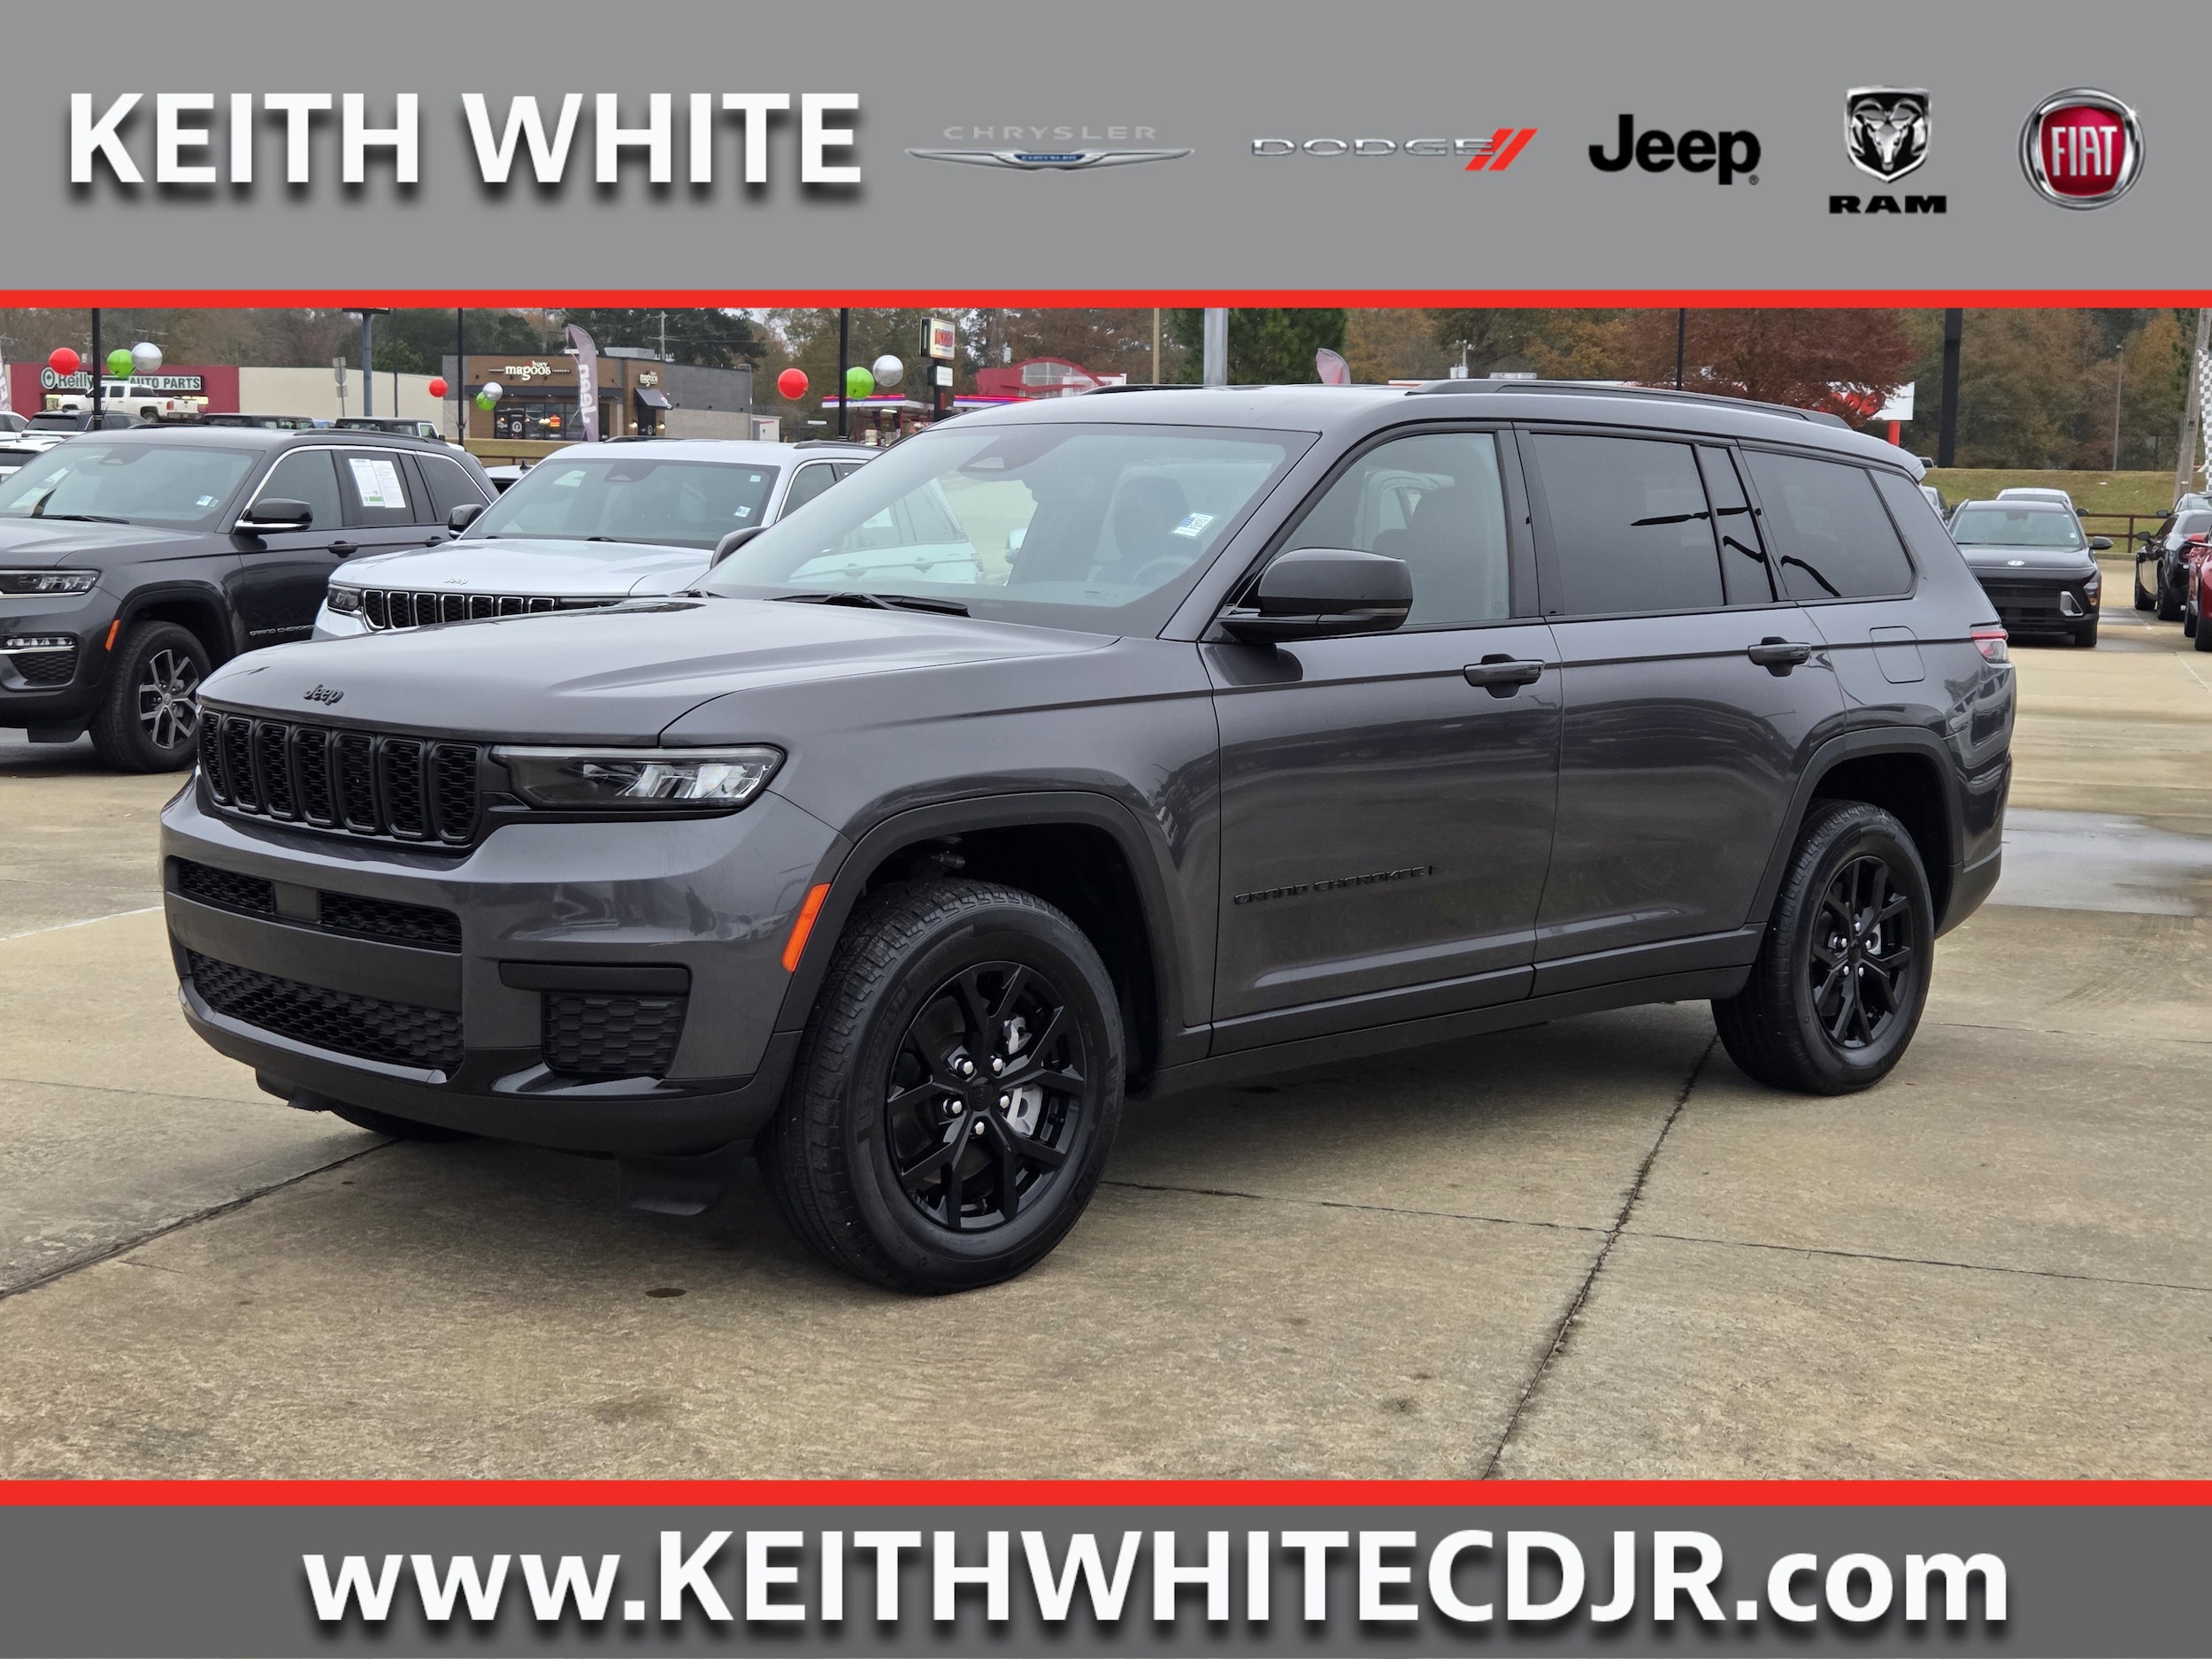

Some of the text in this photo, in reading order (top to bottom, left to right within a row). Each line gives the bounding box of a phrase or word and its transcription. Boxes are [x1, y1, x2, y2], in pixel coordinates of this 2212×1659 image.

[164, 378, 200, 388] PARTS
[444, 576, 469, 585] Jeep
[303, 684, 344, 706] Jeep
[1233, 885, 1309, 905] GRAND
[1313, 866, 1425, 893] CHEROKEE
